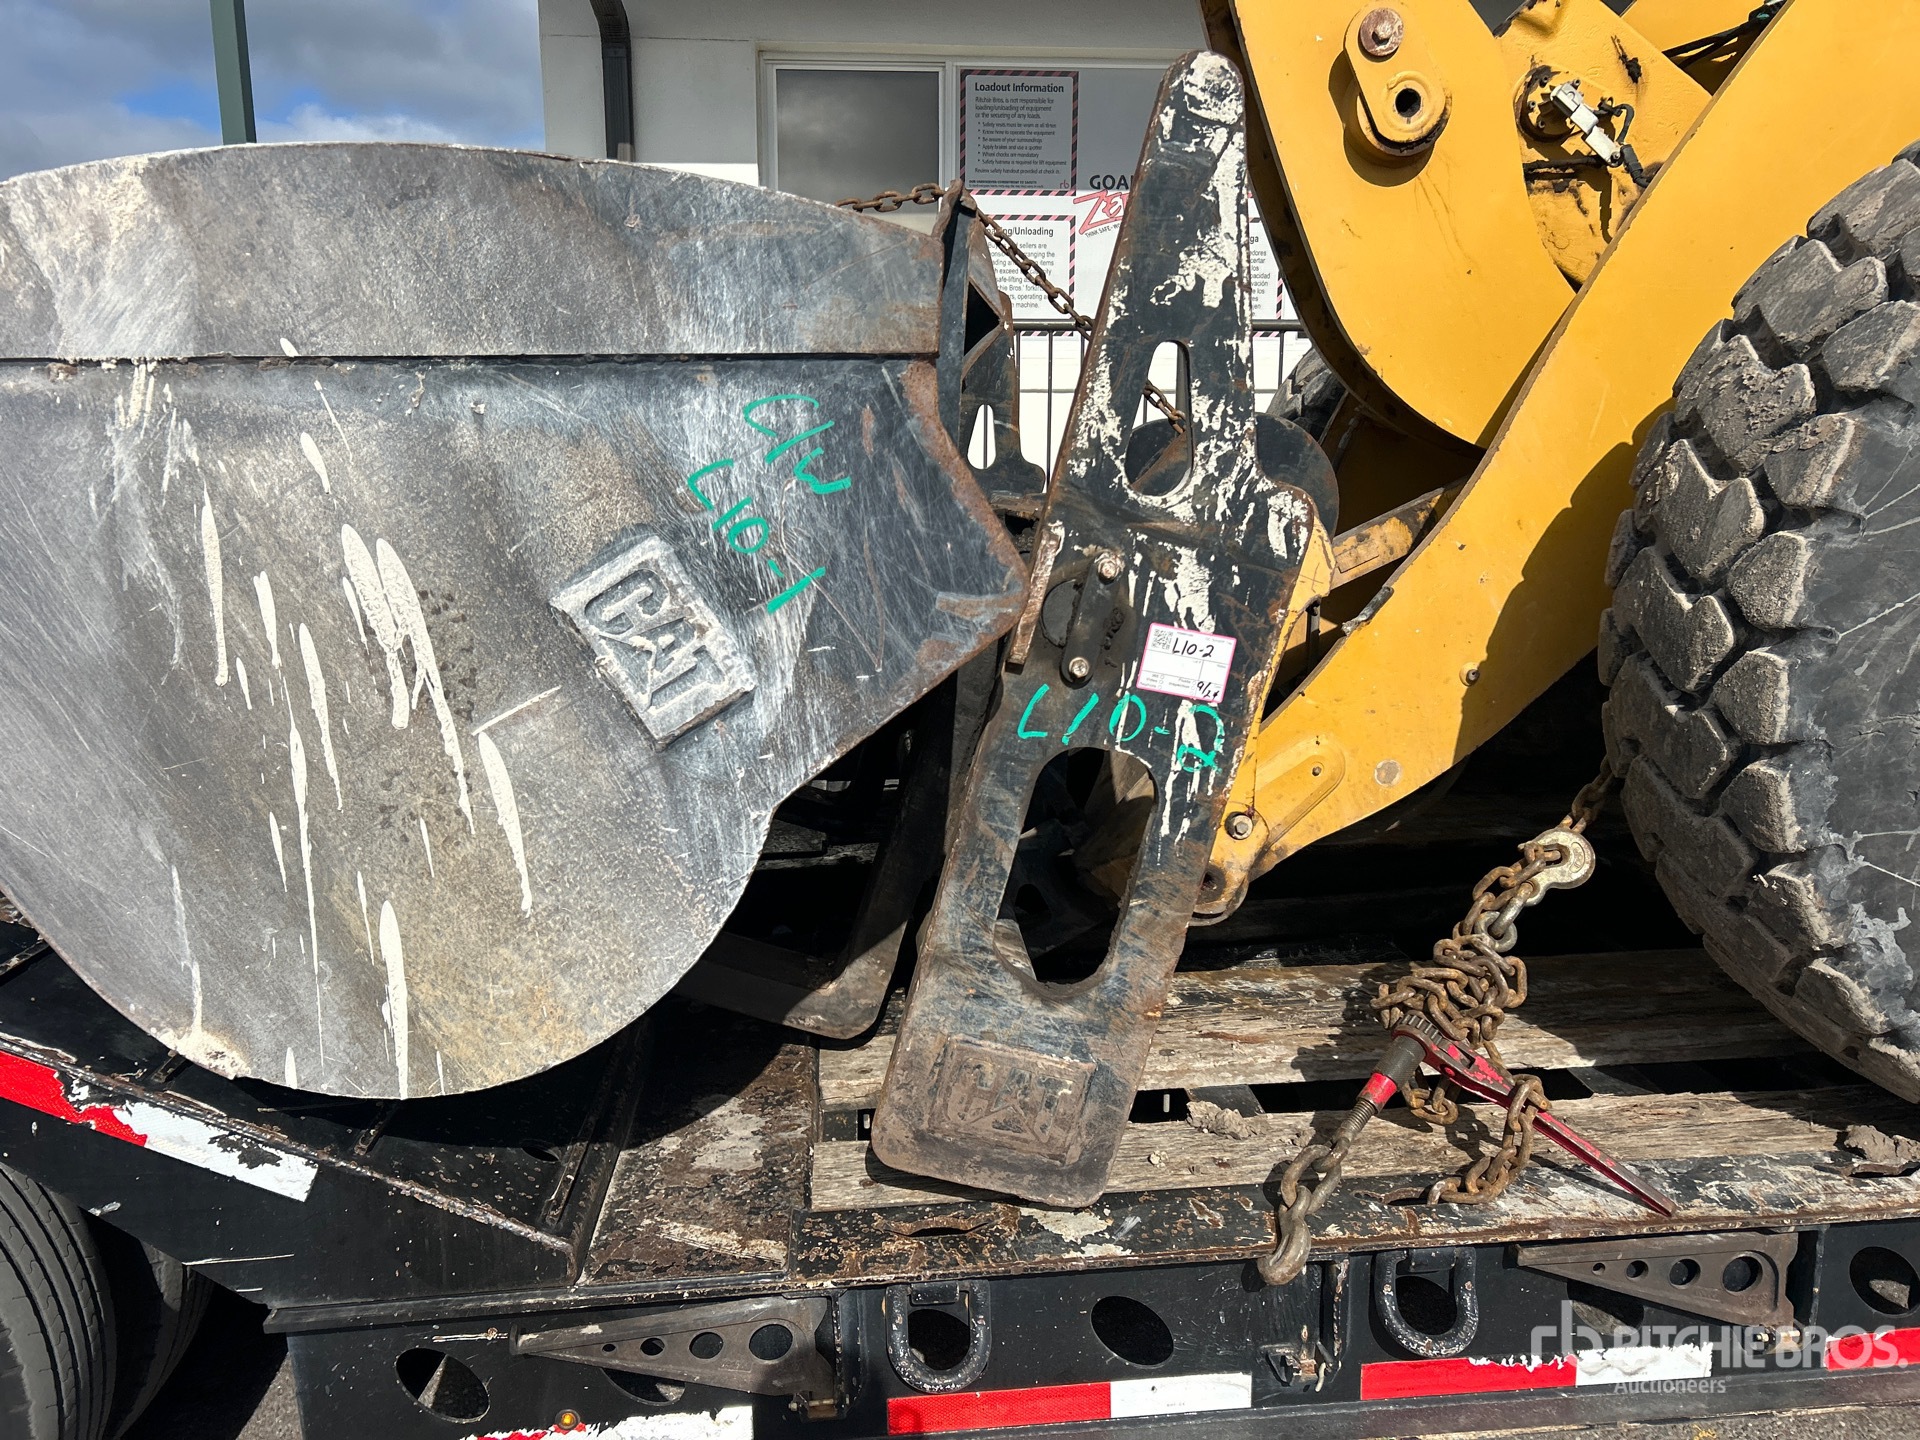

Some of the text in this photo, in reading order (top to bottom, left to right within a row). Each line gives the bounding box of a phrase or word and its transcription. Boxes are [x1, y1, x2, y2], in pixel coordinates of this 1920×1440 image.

[975, 82, 1064, 92] Loadout Information
[583, 568, 729, 717] CAT
[1172, 638, 1215, 658] L10-2
[1017, 683, 1225, 774] L10-2
[946, 1057, 1073, 1143] CAT
